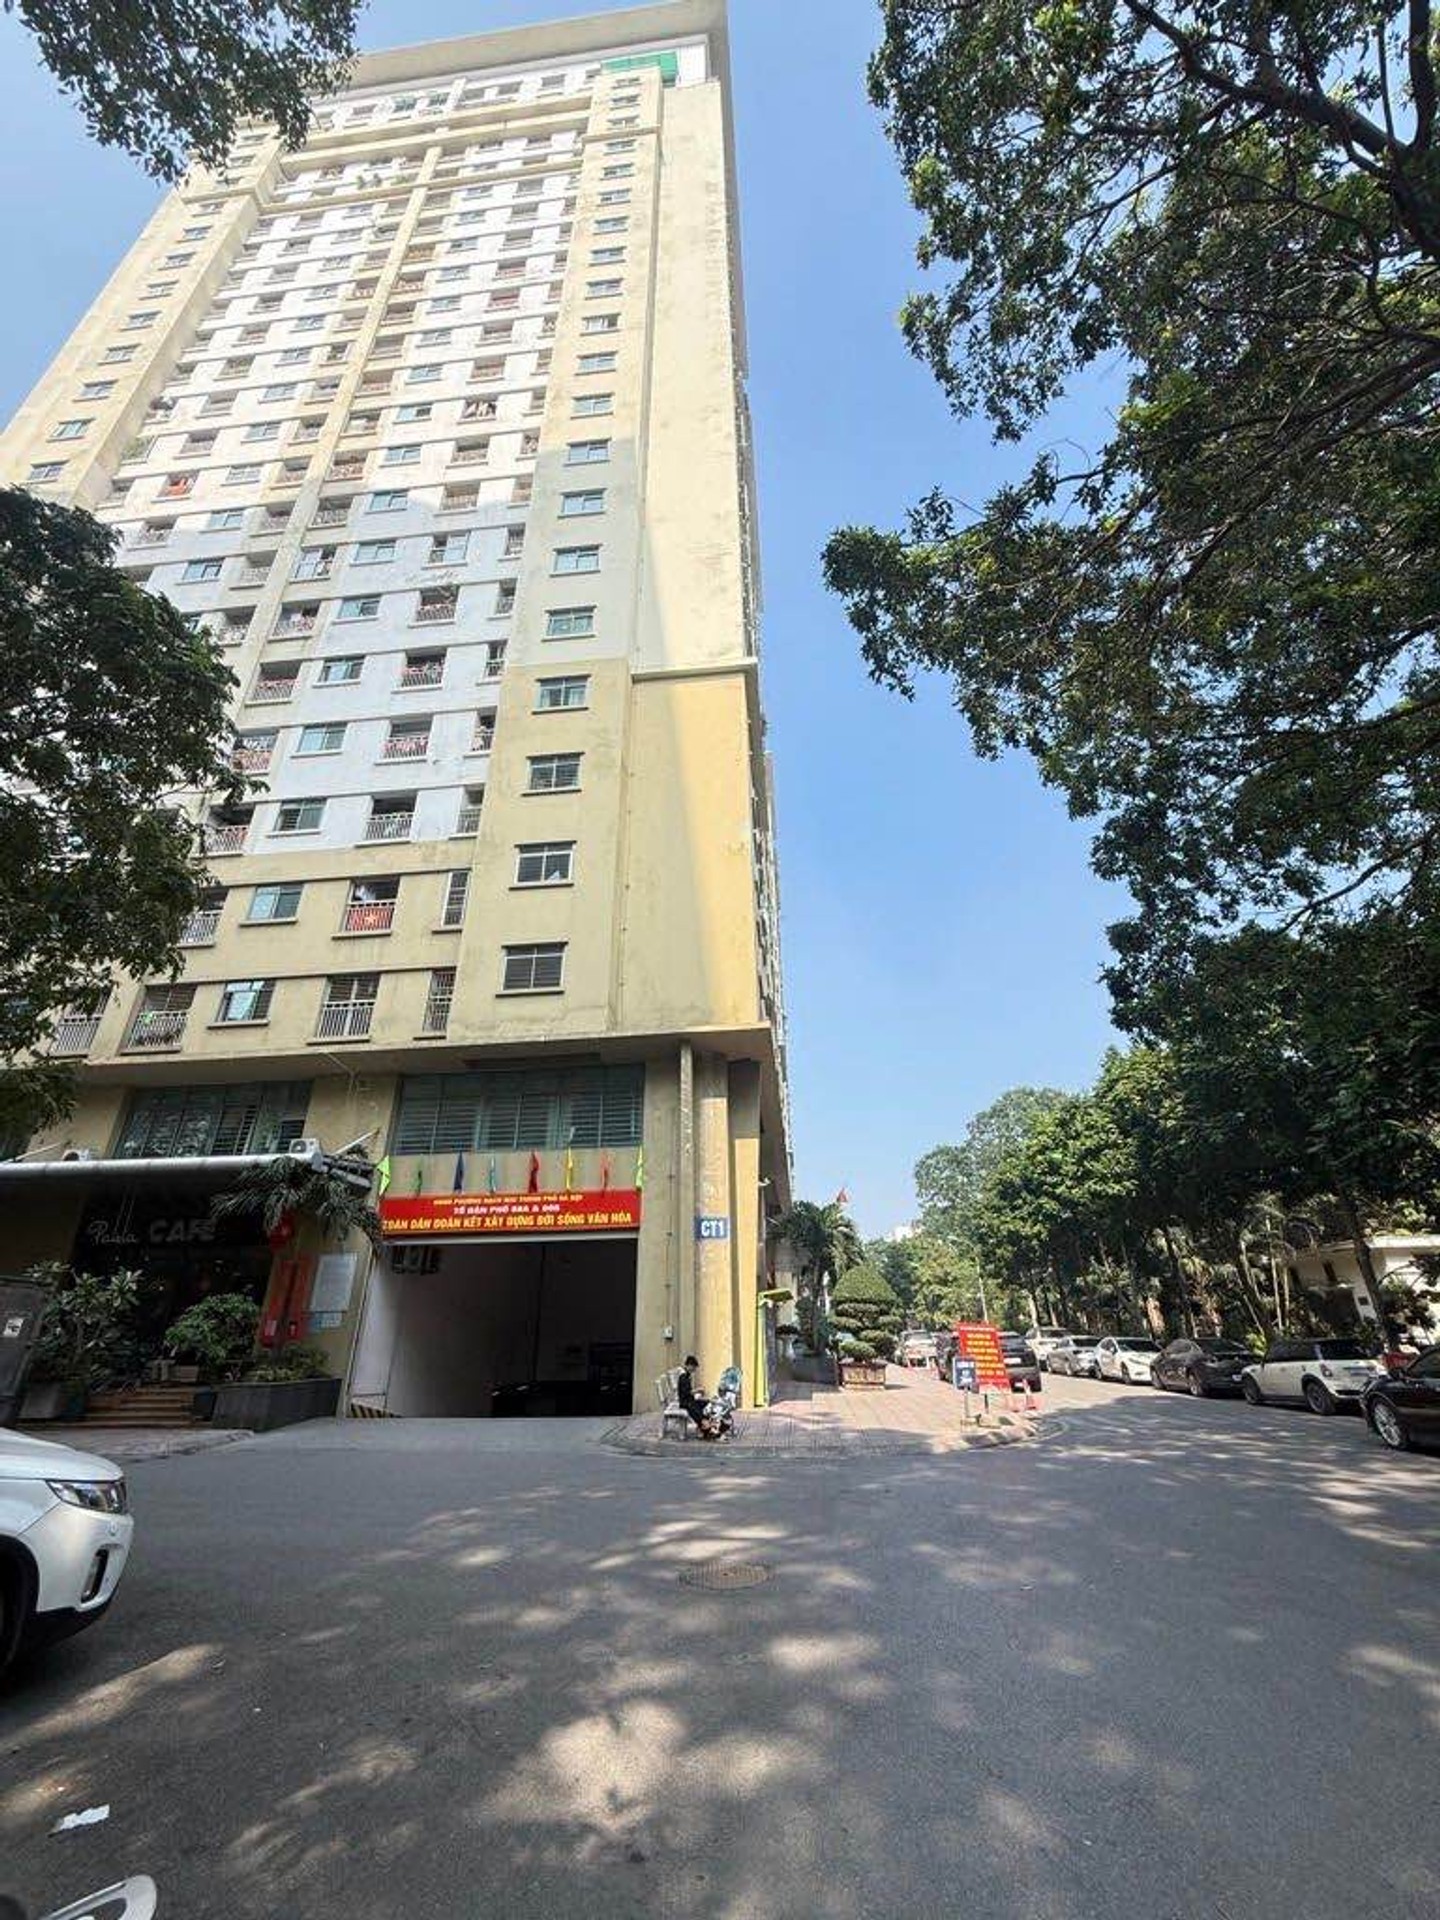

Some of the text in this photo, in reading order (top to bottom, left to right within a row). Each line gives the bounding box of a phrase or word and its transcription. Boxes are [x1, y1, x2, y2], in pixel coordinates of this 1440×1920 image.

[410, 1217, 432, 1230] DÂN
[433, 1216, 461, 1229] ĐOÀN
[463, 1215, 482, 1228] KẾT
[484, 1214, 504, 1228] XÂY
[557, 1211, 585, 1226] SỐNG
[587, 1211, 609, 1224] VĂN
[611, 1209, 632, 1224] HÓA
[701, 1219, 726, 1238] CT1
